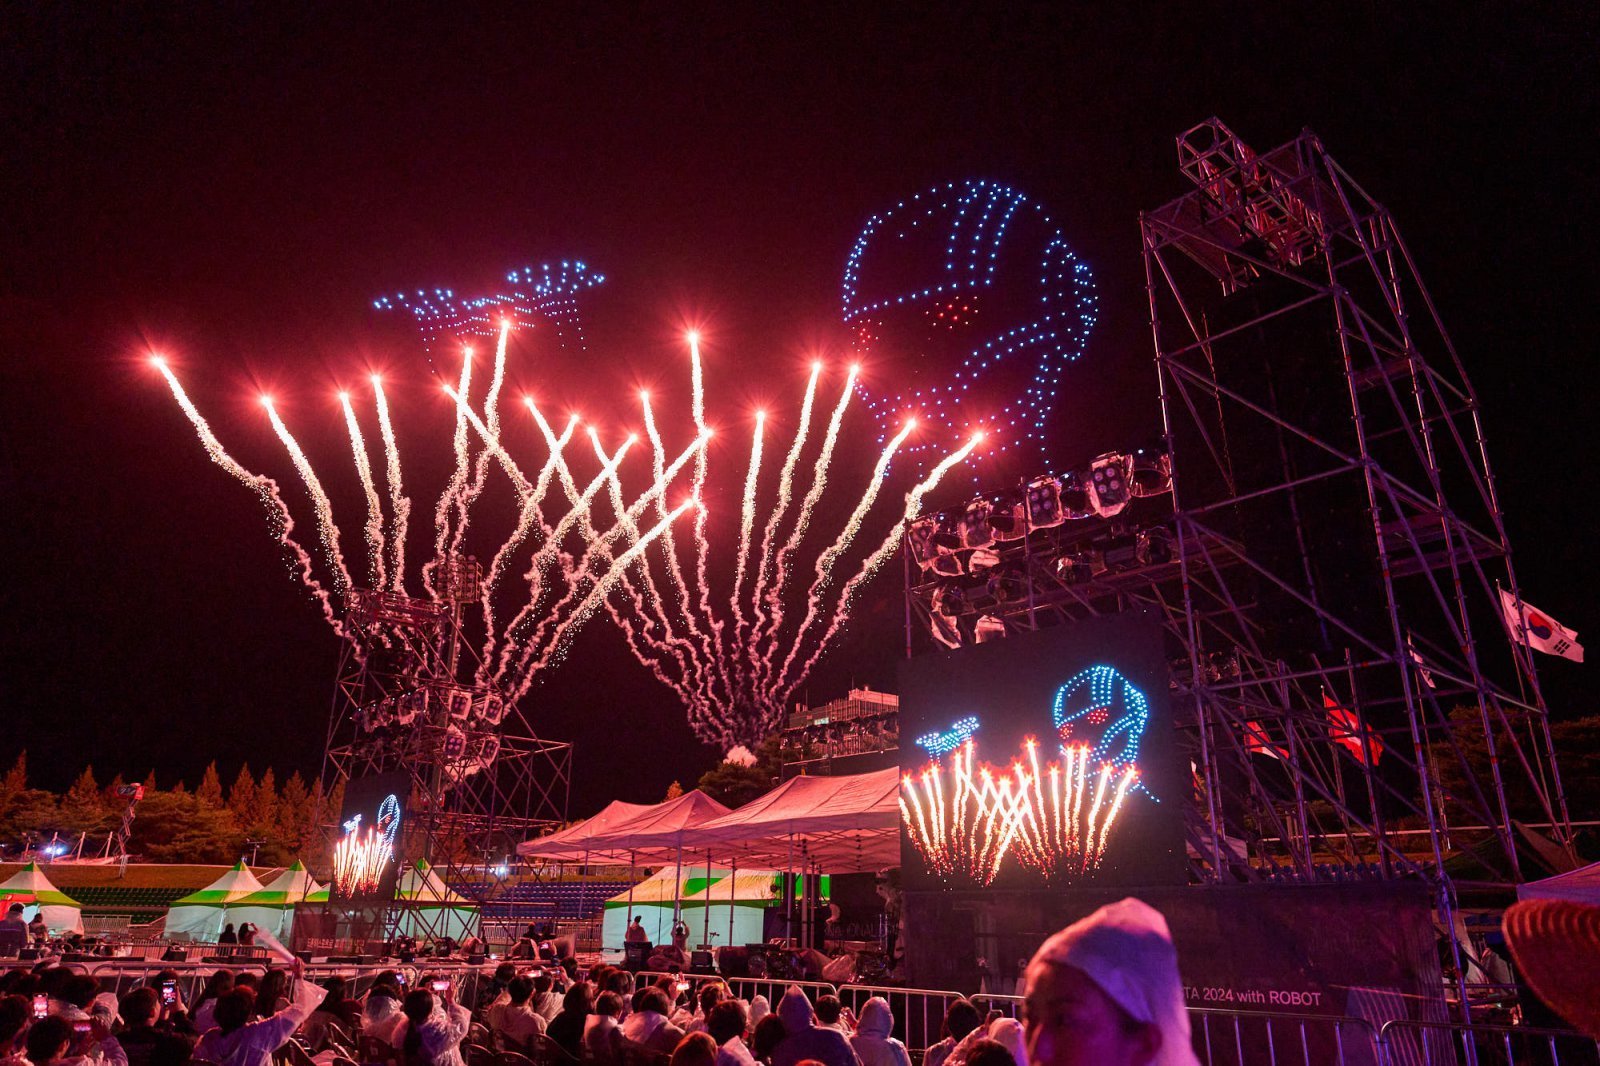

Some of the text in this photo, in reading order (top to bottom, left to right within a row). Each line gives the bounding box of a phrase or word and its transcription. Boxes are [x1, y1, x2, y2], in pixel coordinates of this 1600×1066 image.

[1203, 987, 1234, 1002] 2024
[1237, 989, 1265, 1004] with
[1269, 990, 1321, 1006] ROBOT
